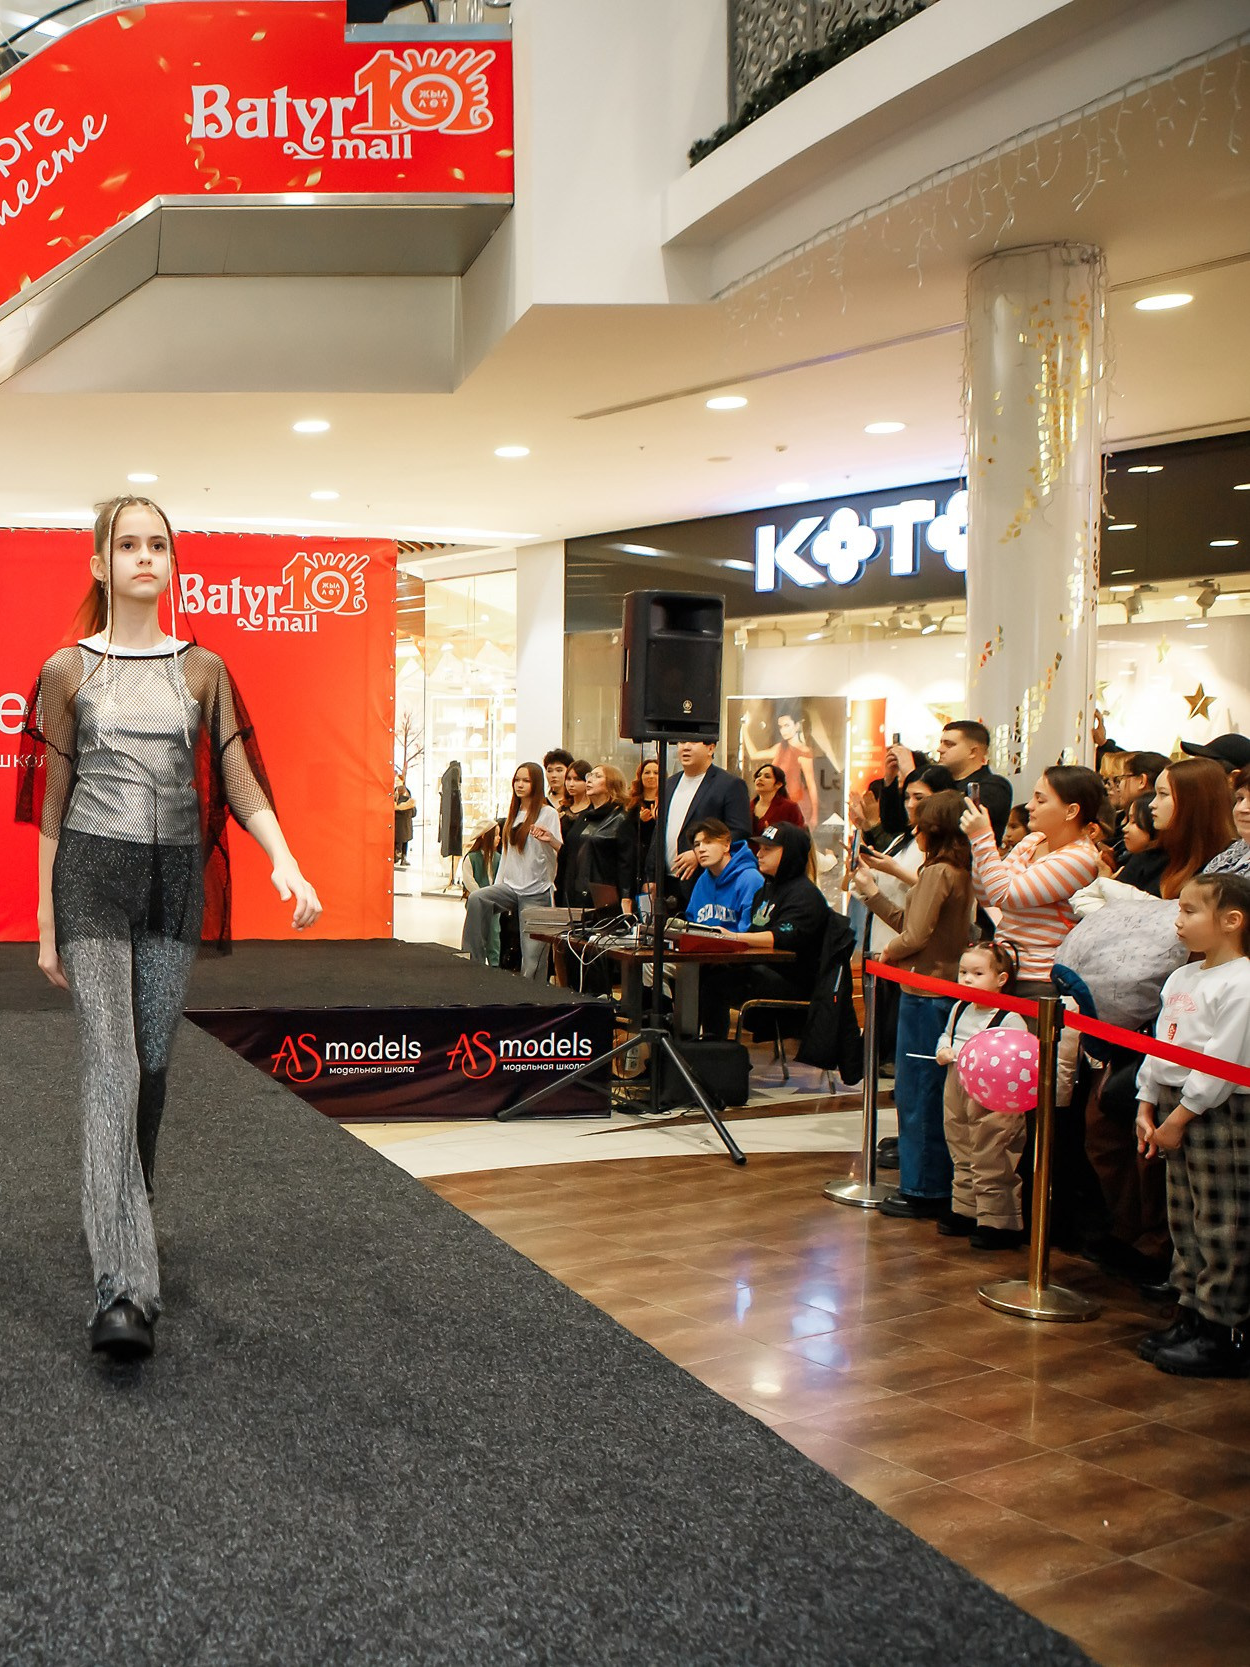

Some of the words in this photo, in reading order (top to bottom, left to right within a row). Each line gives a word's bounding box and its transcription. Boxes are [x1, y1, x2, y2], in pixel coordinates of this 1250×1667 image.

[191, 84, 356, 159] Batyr
[331, 134, 412, 159] mall
[178, 573, 284, 631] Batyr
[267, 614, 318, 632] mall
[271, 1033, 322, 1083] AS
[325, 1035, 422, 1060] models
[329, 1066, 382, 1076] модельная
[384, 1065, 415, 1074] школа
[446, 1031, 496, 1079] AS
[499, 1032, 592, 1057] models
[502, 1063, 553, 1073] модельная
